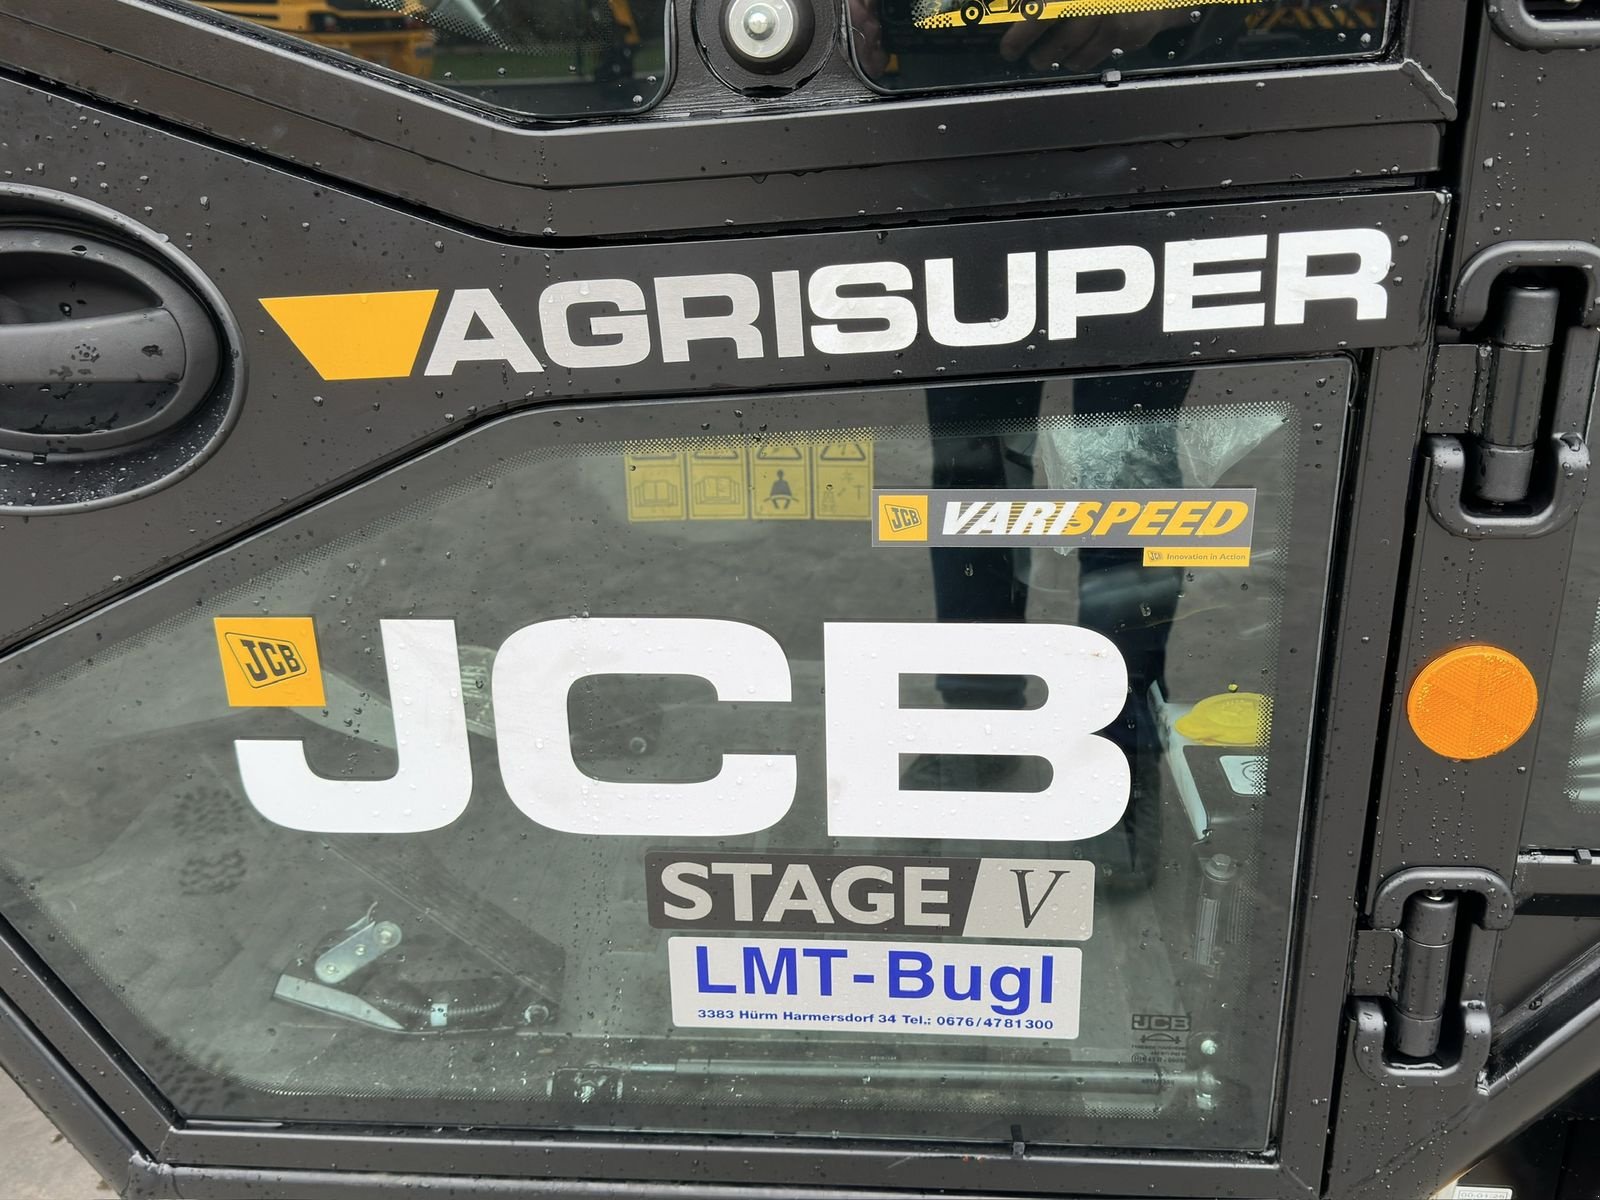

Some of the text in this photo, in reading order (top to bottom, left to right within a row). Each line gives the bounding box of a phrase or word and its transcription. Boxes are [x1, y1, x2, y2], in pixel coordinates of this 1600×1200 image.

[424, 227, 1393, 377] AGRISUPER
[891, 501, 1249, 536] JCB VARISPEED
[1167, 553, 1207, 561] Innovation
[1210, 553, 1218, 561] in
[1220, 553, 1246, 561] Action
[240, 638, 301, 682] JCB
[234, 617, 1131, 842] JCB
[661, 861, 1071, 929] STAGE V
[695, 945, 1054, 1016] LMT-Bugl
[698, 1009, 1054, 1030] 3383 Hürm Harmersdorf 34 Tel.: 0676/4781300
[1132, 1015, 1190, 1031] JCB
